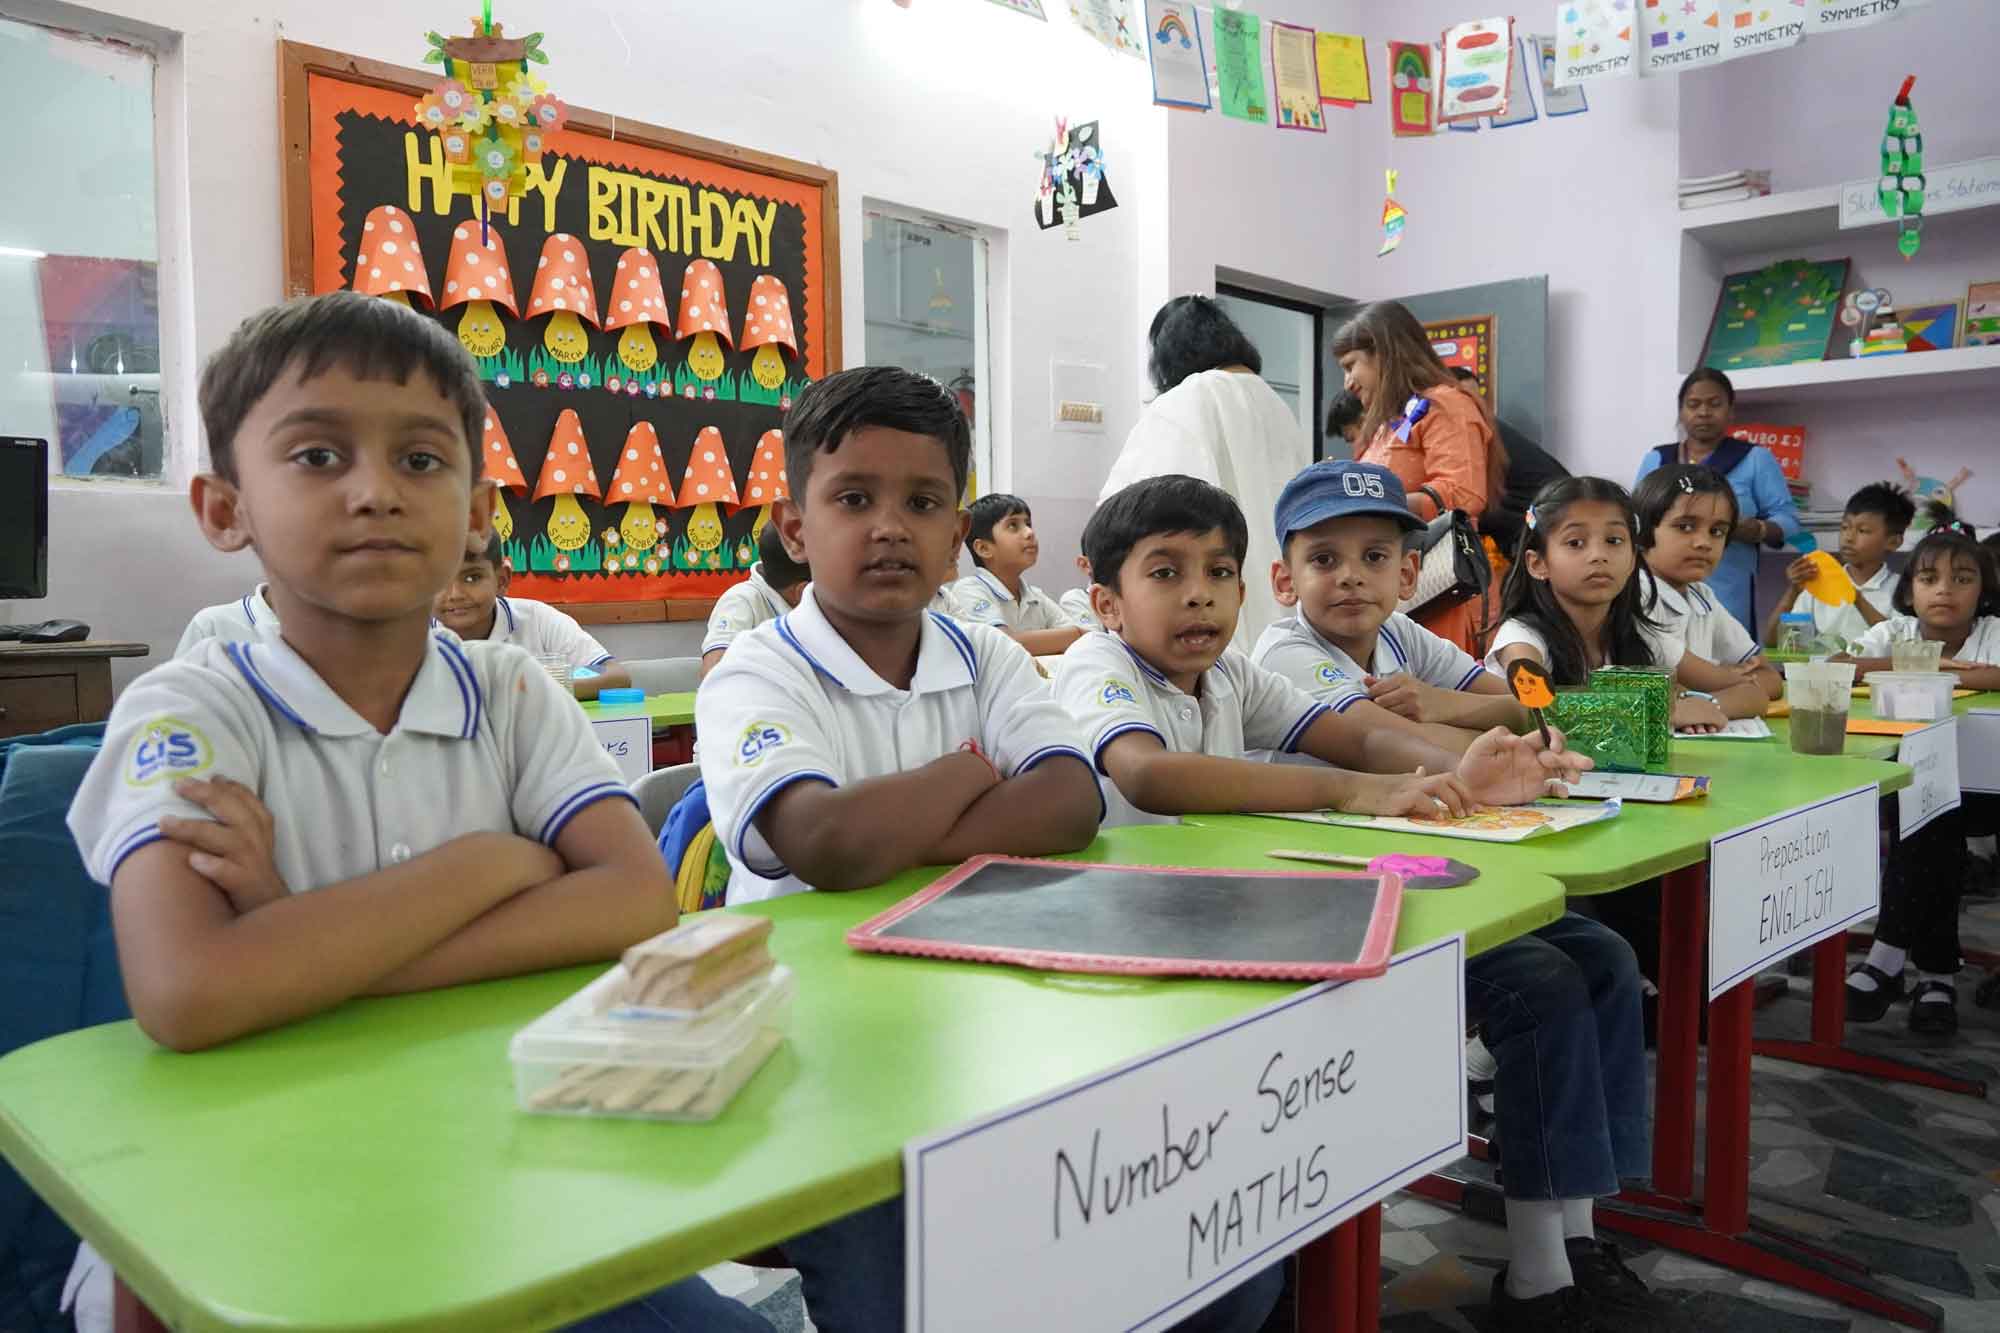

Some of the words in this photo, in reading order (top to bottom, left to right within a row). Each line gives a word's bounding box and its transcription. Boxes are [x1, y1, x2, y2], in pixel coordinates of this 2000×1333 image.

[1820, 0, 1901, 23] SYMMETRY
[1733, 21, 1804, 48] SYMMETRY
[1567, 55, 1630, 78] SYMMETRY
[1651, 42, 1720, 68] SYMMETRY
[404, 131, 567, 232] HPY
[588, 166, 777, 266] BIRTHDAY
[550, 345, 583, 359] MARCH
[623, 355, 651, 369] APRIL
[697, 366, 716, 380] MAY
[758, 372, 781, 386] JUNE
[1342, 472, 1385, 498] 05
[549, 521, 590, 549] SEPTEMBER
[622, 528, 657, 549] OCTOBER
[687, 527, 721, 549] NOVEMBER
[1760, 816, 1831, 880] Preposition
[1760, 864, 1834, 944] ENGLISH
[1054, 1103, 1229, 1241] Number
[1257, 1050, 1357, 1133] Sense
[1187, 1144, 1329, 1280] MATHS
